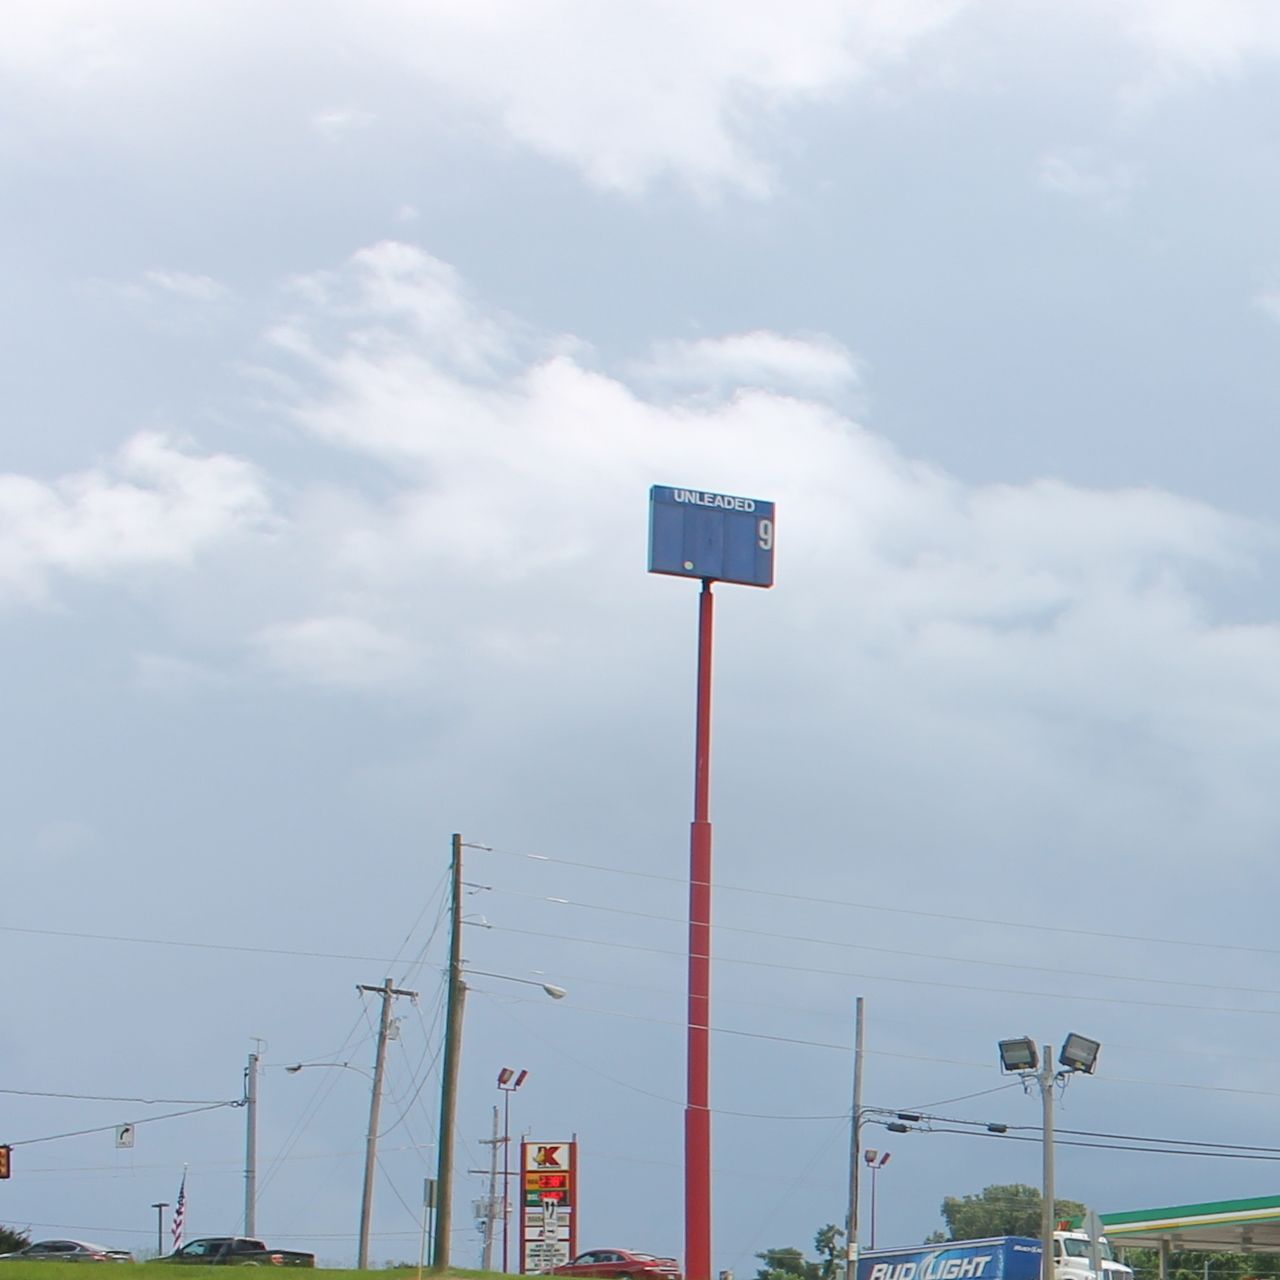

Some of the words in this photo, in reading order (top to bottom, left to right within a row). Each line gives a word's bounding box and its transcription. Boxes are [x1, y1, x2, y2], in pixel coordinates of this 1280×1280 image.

[673, 489, 755, 512] UNLEADED
[758, 519, 773, 551] 9
[537, 1146, 561, 1166] K
[924, 1255, 993, 1280] LIGHT
